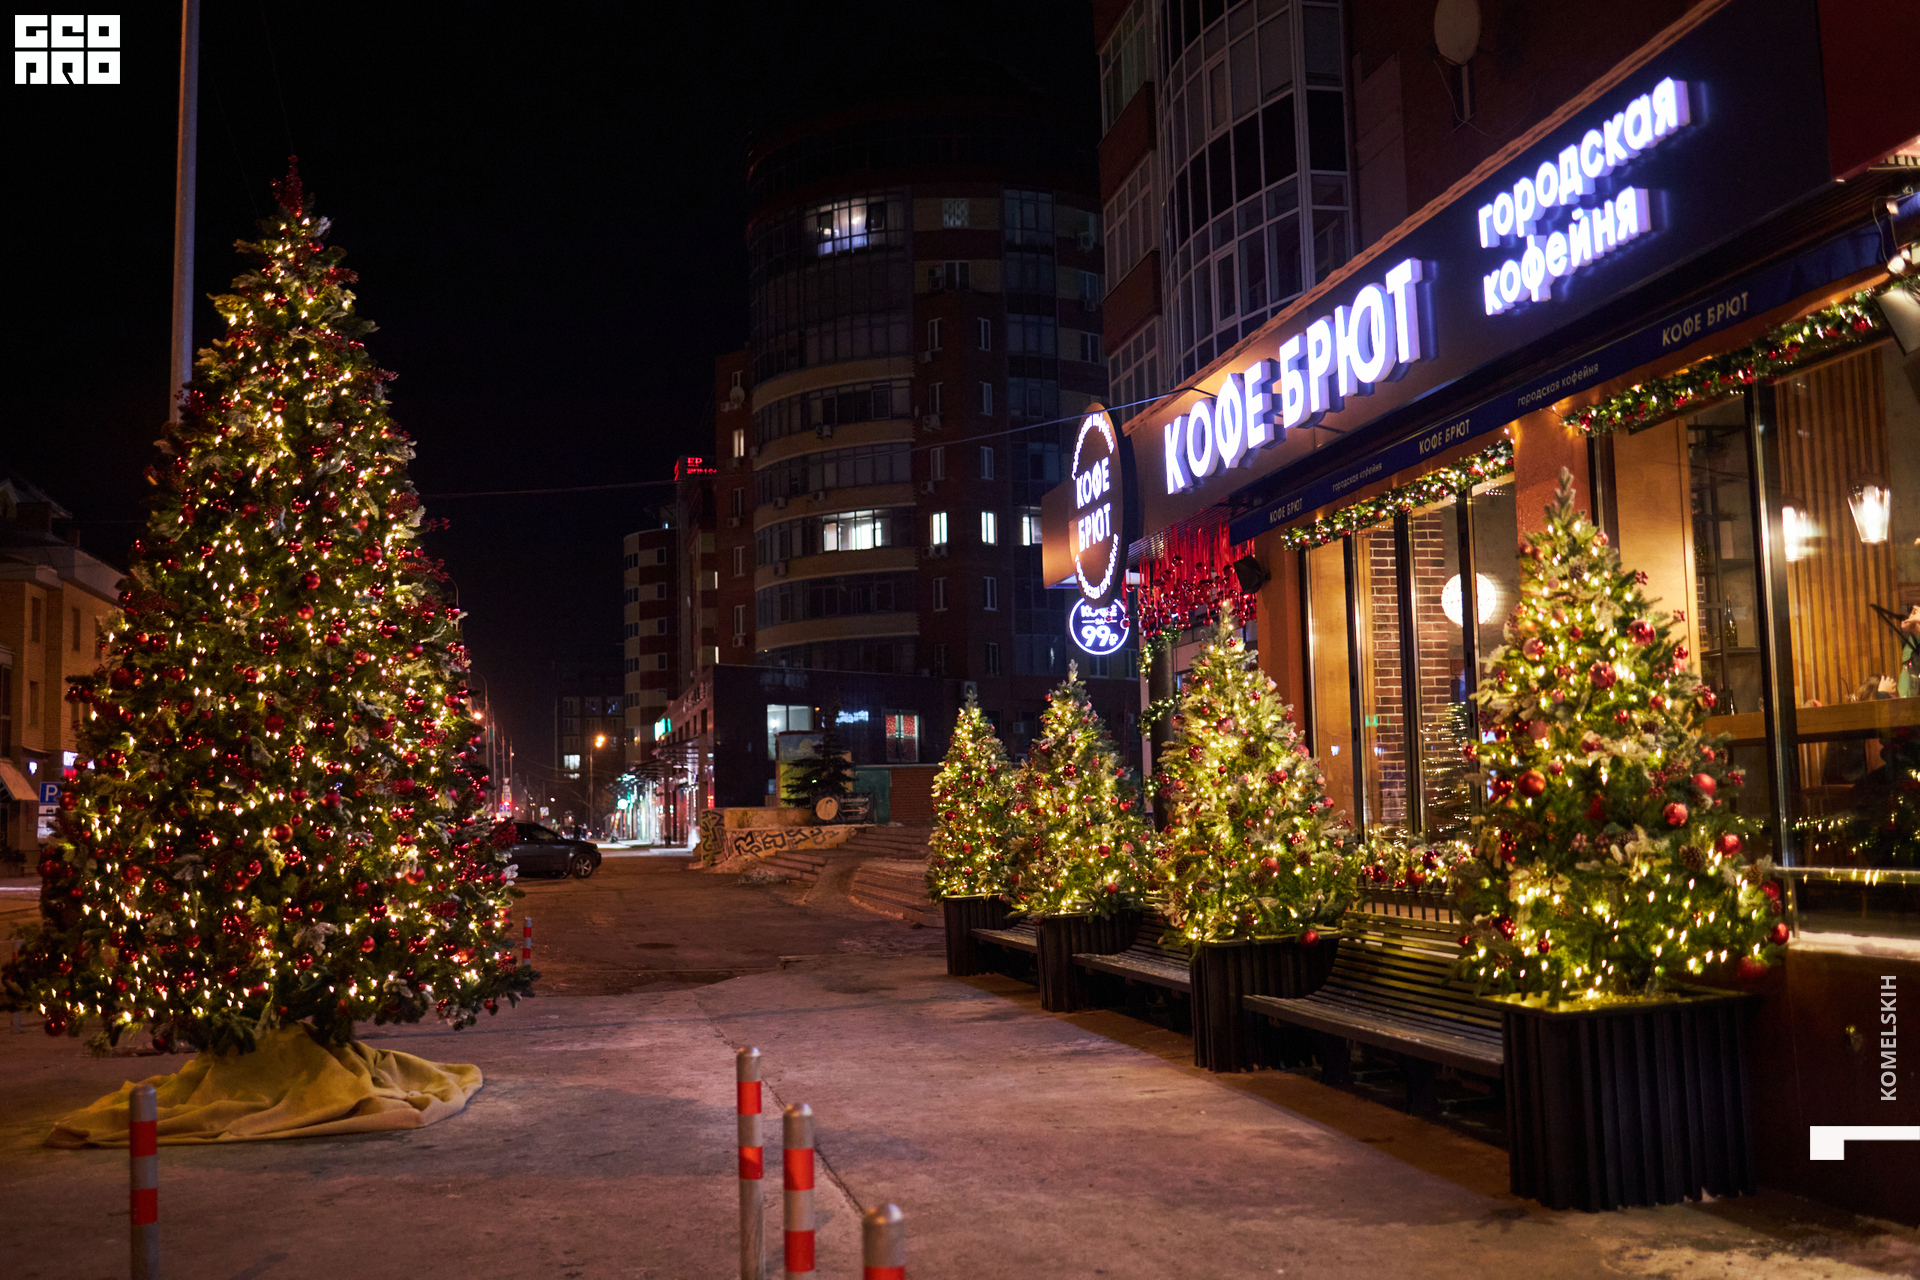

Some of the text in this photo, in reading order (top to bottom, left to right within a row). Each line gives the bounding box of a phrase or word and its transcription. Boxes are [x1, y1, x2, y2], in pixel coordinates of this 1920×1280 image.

[1478, 76, 1686, 249] городская
[1483, 185, 1648, 316] кофейня
[1662, 291, 1749, 347] КОФЕ БРЮТ
[1164, 257, 1421, 495] КОФЕ БРЮТ
[1517, 363, 1599, 407] городская кофейня
[1418, 418, 1470, 455] КОФЕ БРЮТ
[1075, 456, 1110, 510] КОФЕ
[1332, 462, 1383, 493] городская кофейня
[1077, 502, 1111, 553] БРЮТ
[1269, 498, 1303, 524] КОФЕ БРЮТ
[45, 784, 58, 802] P
